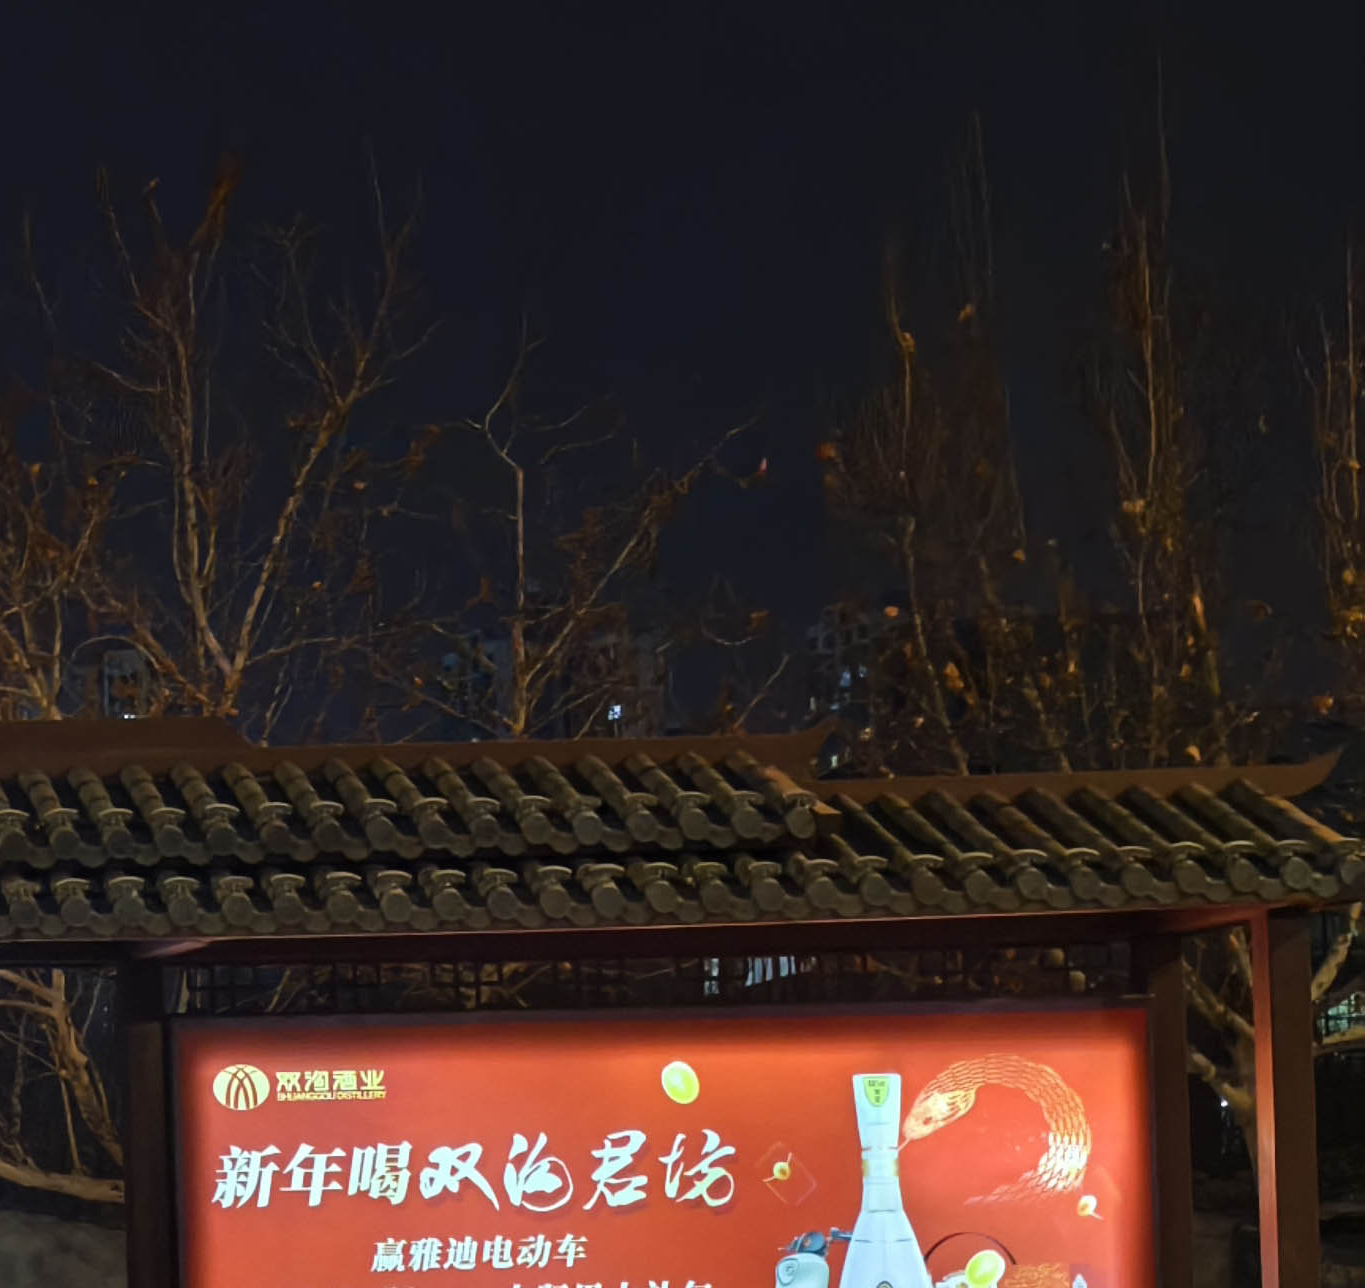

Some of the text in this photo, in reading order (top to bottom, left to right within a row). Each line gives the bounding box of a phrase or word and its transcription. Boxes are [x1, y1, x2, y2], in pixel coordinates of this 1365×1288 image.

[275, 1070, 385, 1091] 双沟酒业
[212, 1130, 736, 1212] 新年喝双沟君坊
[370, 1234, 588, 1273] 赢雅迪电动车
